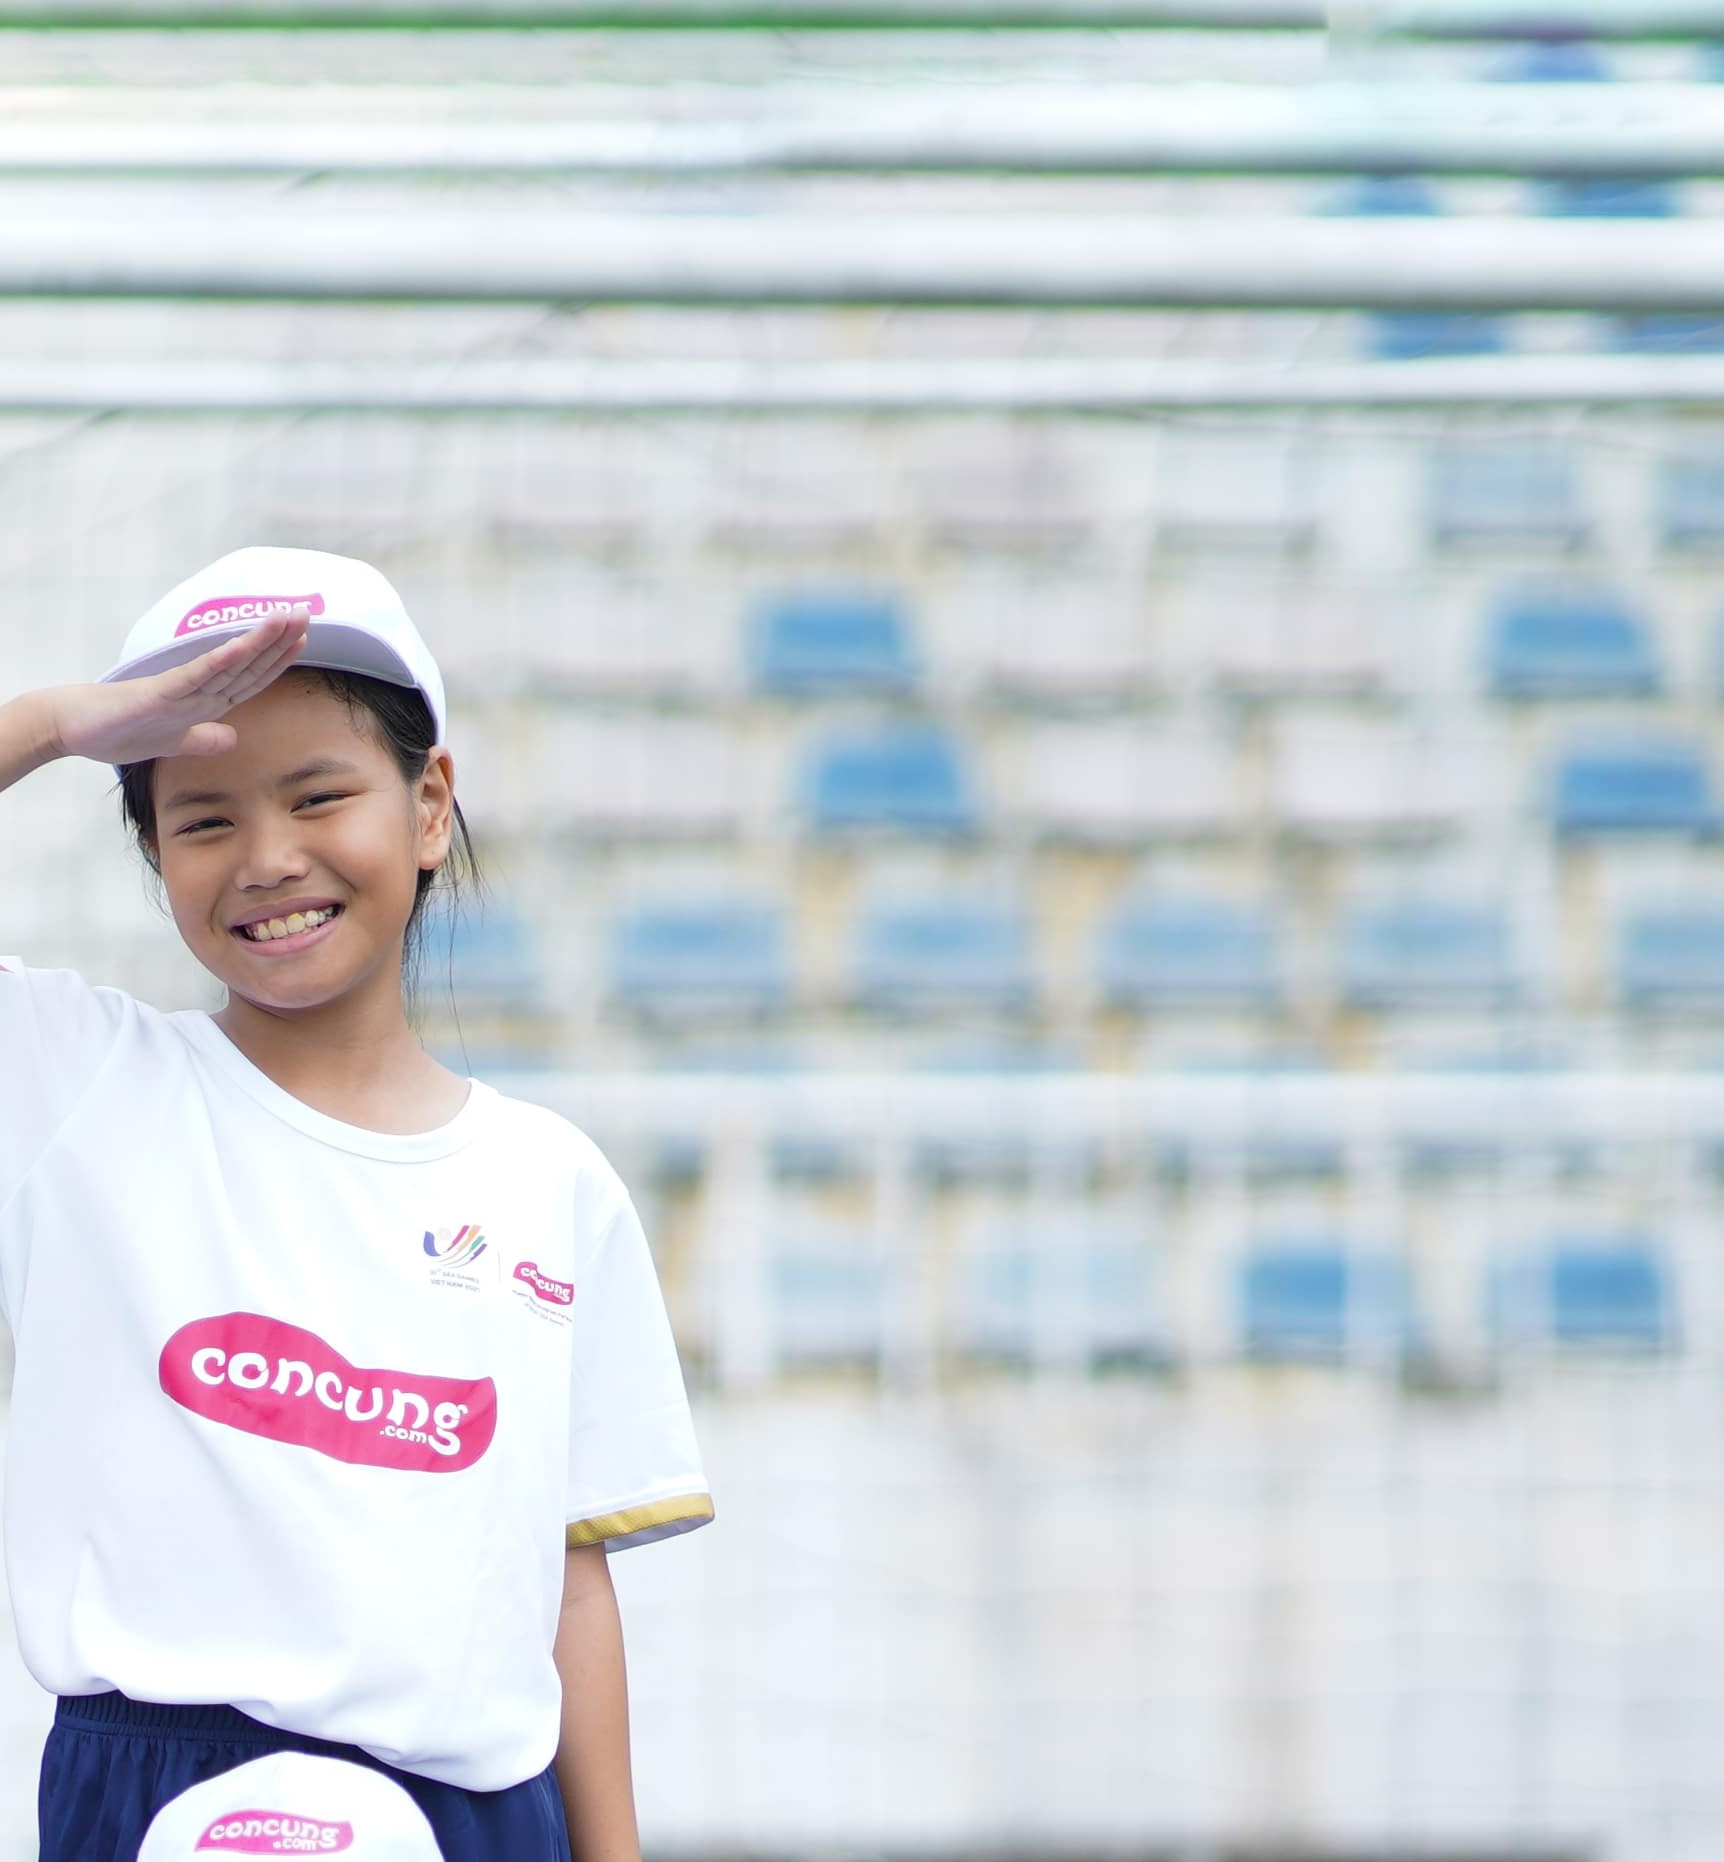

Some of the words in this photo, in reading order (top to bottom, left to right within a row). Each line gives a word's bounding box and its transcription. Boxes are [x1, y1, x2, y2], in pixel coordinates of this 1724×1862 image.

[187, 600, 312, 628] concun
[520, 1267, 571, 1302] cocung
[190, 1347, 469, 1456] concung
[379, 1425, 428, 1444] .com
[209, 1818, 340, 1849] concung
